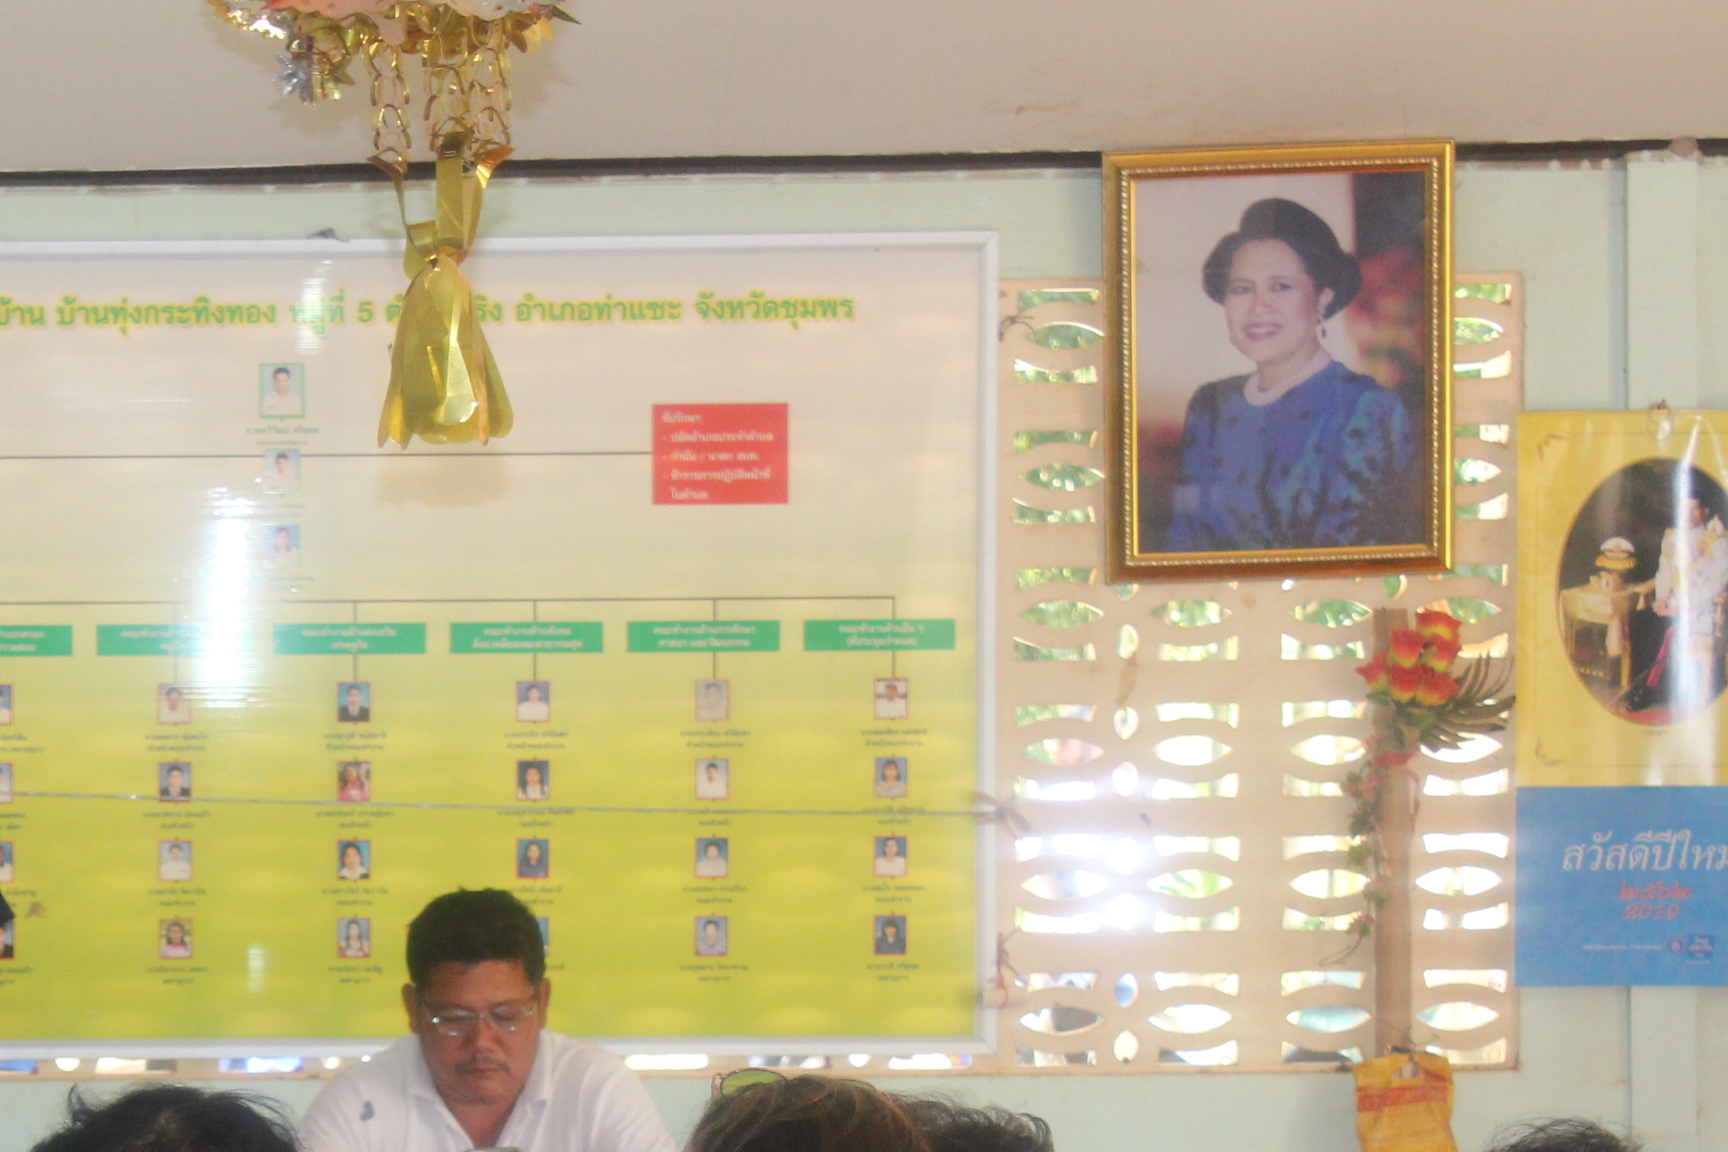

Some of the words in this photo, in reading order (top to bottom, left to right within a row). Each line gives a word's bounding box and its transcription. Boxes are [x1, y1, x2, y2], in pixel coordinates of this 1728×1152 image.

[56, 296, 276, 336] บ้านทุ่งกระทิงทอง
[357, 301, 374, 323] 5
[516, 294, 683, 323] อำเภอท่าแซะ
[694, 291, 854, 329] จังหวัดชุมพร
[1623, 903, 1680, 920] 2019
